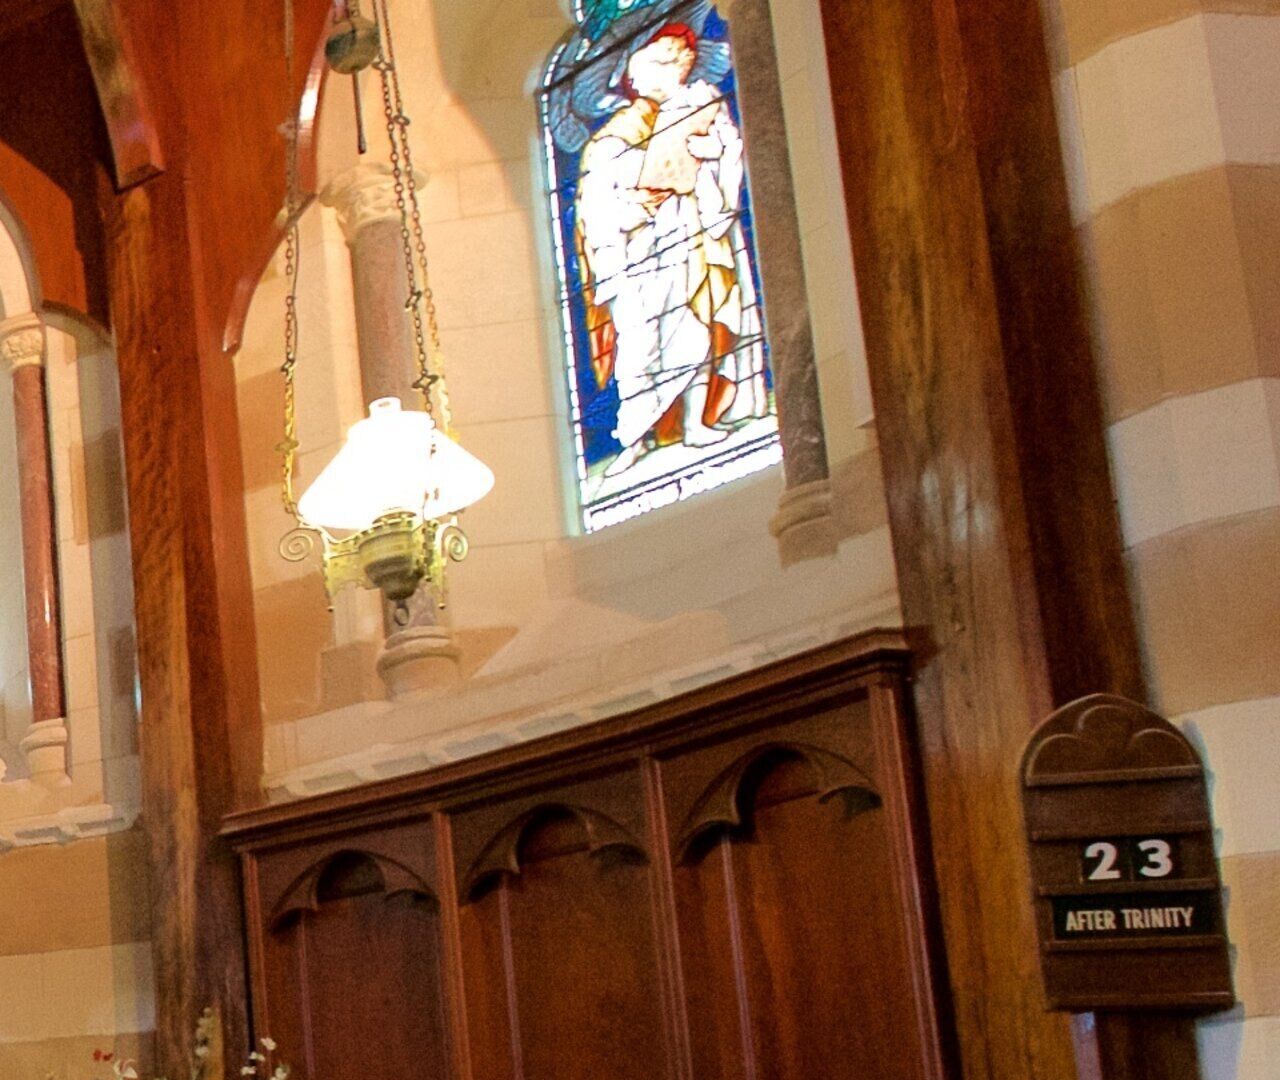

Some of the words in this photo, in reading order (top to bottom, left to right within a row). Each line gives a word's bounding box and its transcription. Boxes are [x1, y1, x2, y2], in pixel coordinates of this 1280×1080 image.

[1085, 839, 1174, 880] 23
[1066, 909, 1117, 932] AFTER
[1121, 906, 1194, 931] TRINITY
